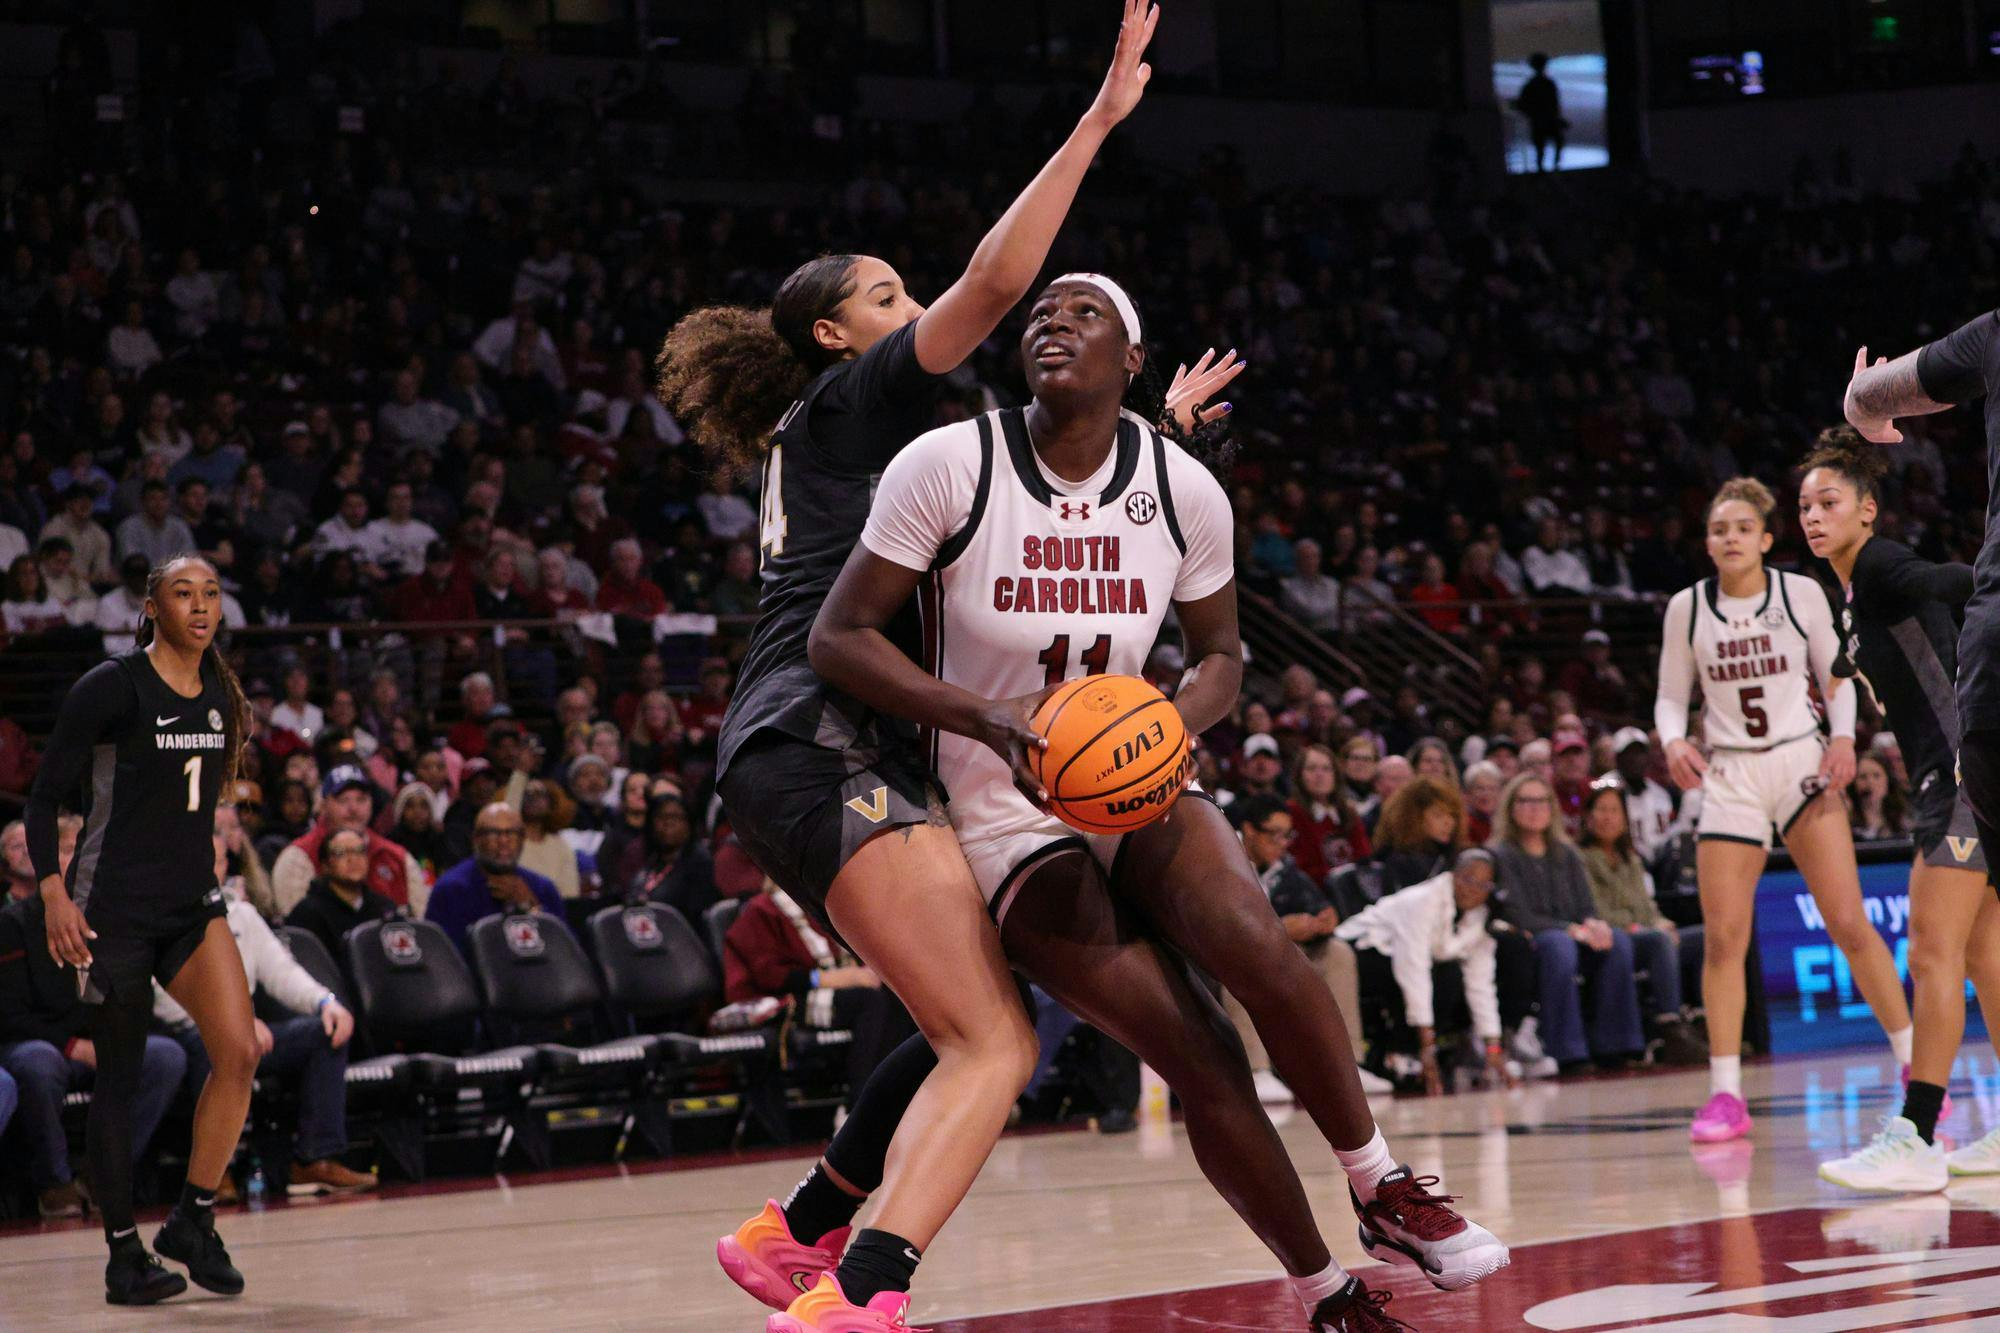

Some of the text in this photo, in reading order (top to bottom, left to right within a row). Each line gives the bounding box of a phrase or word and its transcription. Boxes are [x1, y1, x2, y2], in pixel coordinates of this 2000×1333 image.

[1127, 492, 1155, 523] SEC
[1023, 535, 1120, 572] SOUTH
[993, 576, 1148, 614] CAROLINA
[1717, 634, 1772, 659] SOUTH
[1707, 655, 1789, 682] CAROLINA
[1738, 686, 1769, 738] 5
[1113, 720, 1164, 770] EVO
[183, 755, 203, 812] 1
[1095, 766, 1115, 783] NXT
[844, 786, 888, 824] V
[1945, 835, 1979, 863] V
